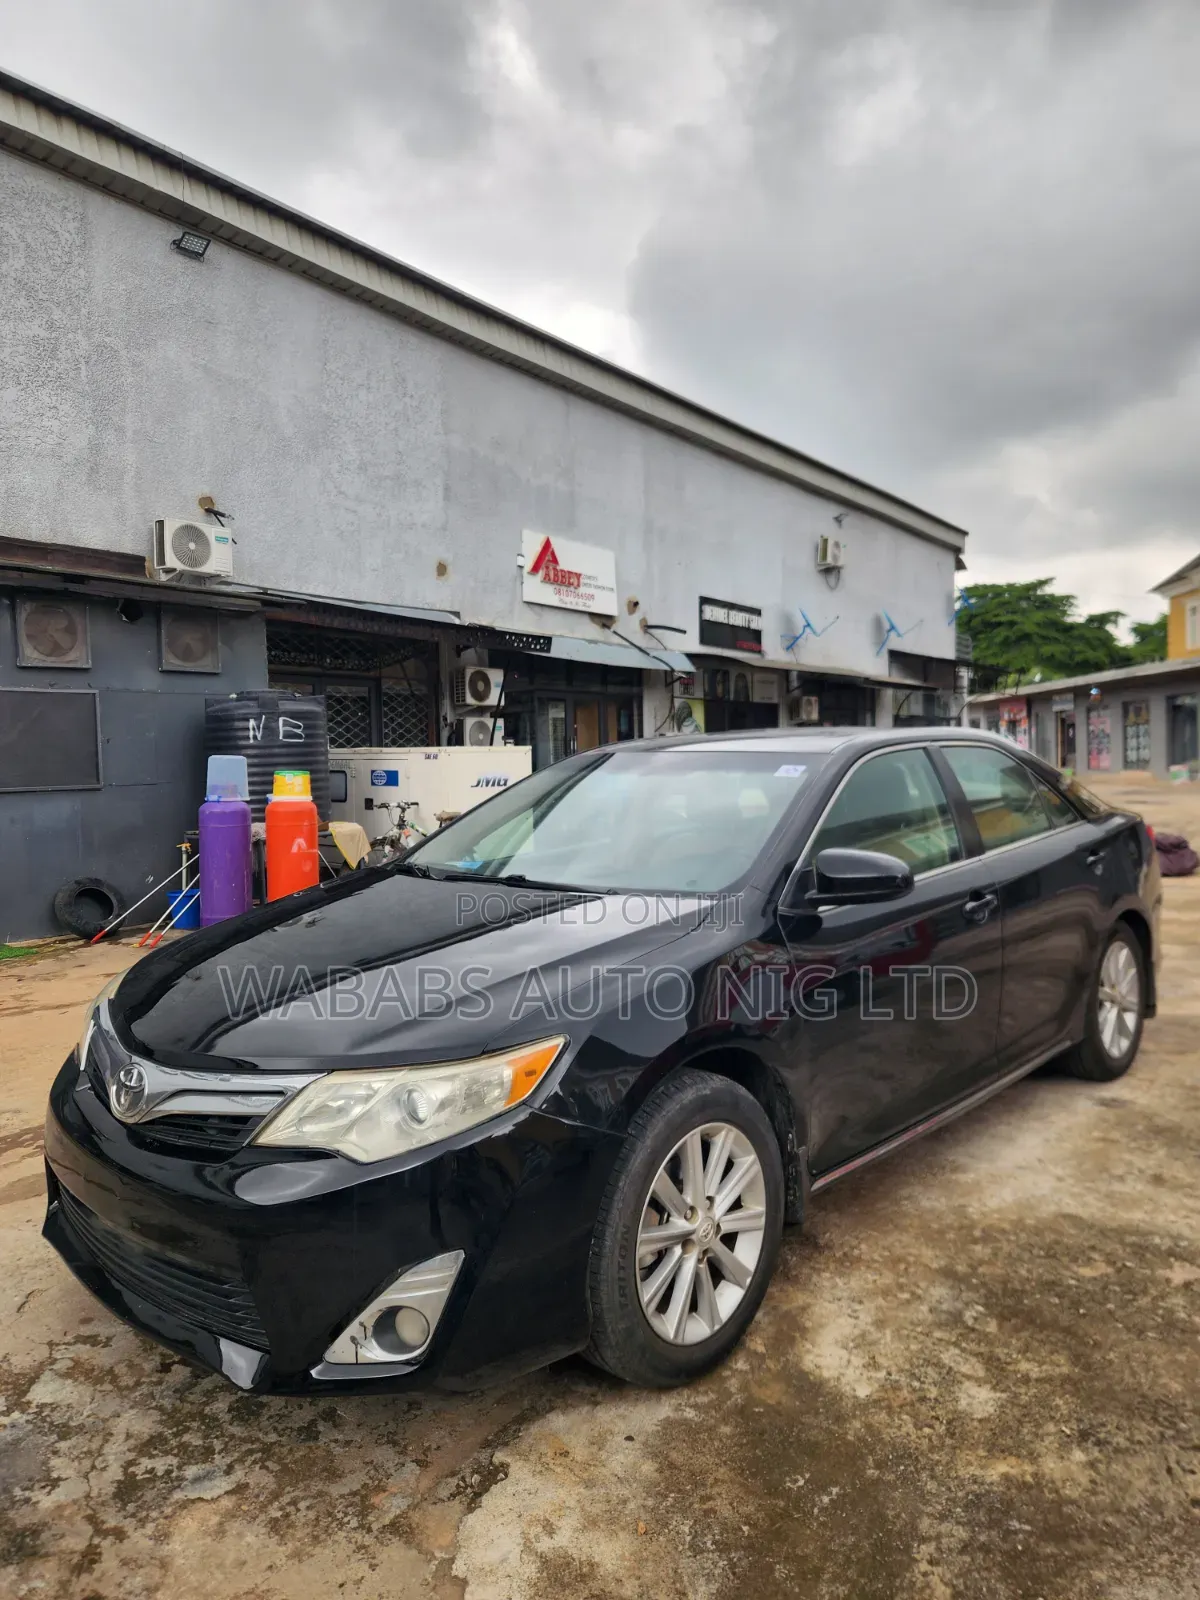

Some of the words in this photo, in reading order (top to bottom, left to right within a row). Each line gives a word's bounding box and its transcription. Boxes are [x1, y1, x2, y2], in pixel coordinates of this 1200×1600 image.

[542, 565, 582, 588] ABBEY
[471, 776, 509, 788] JMG
[617, 1222, 631, 1312] TRITON
